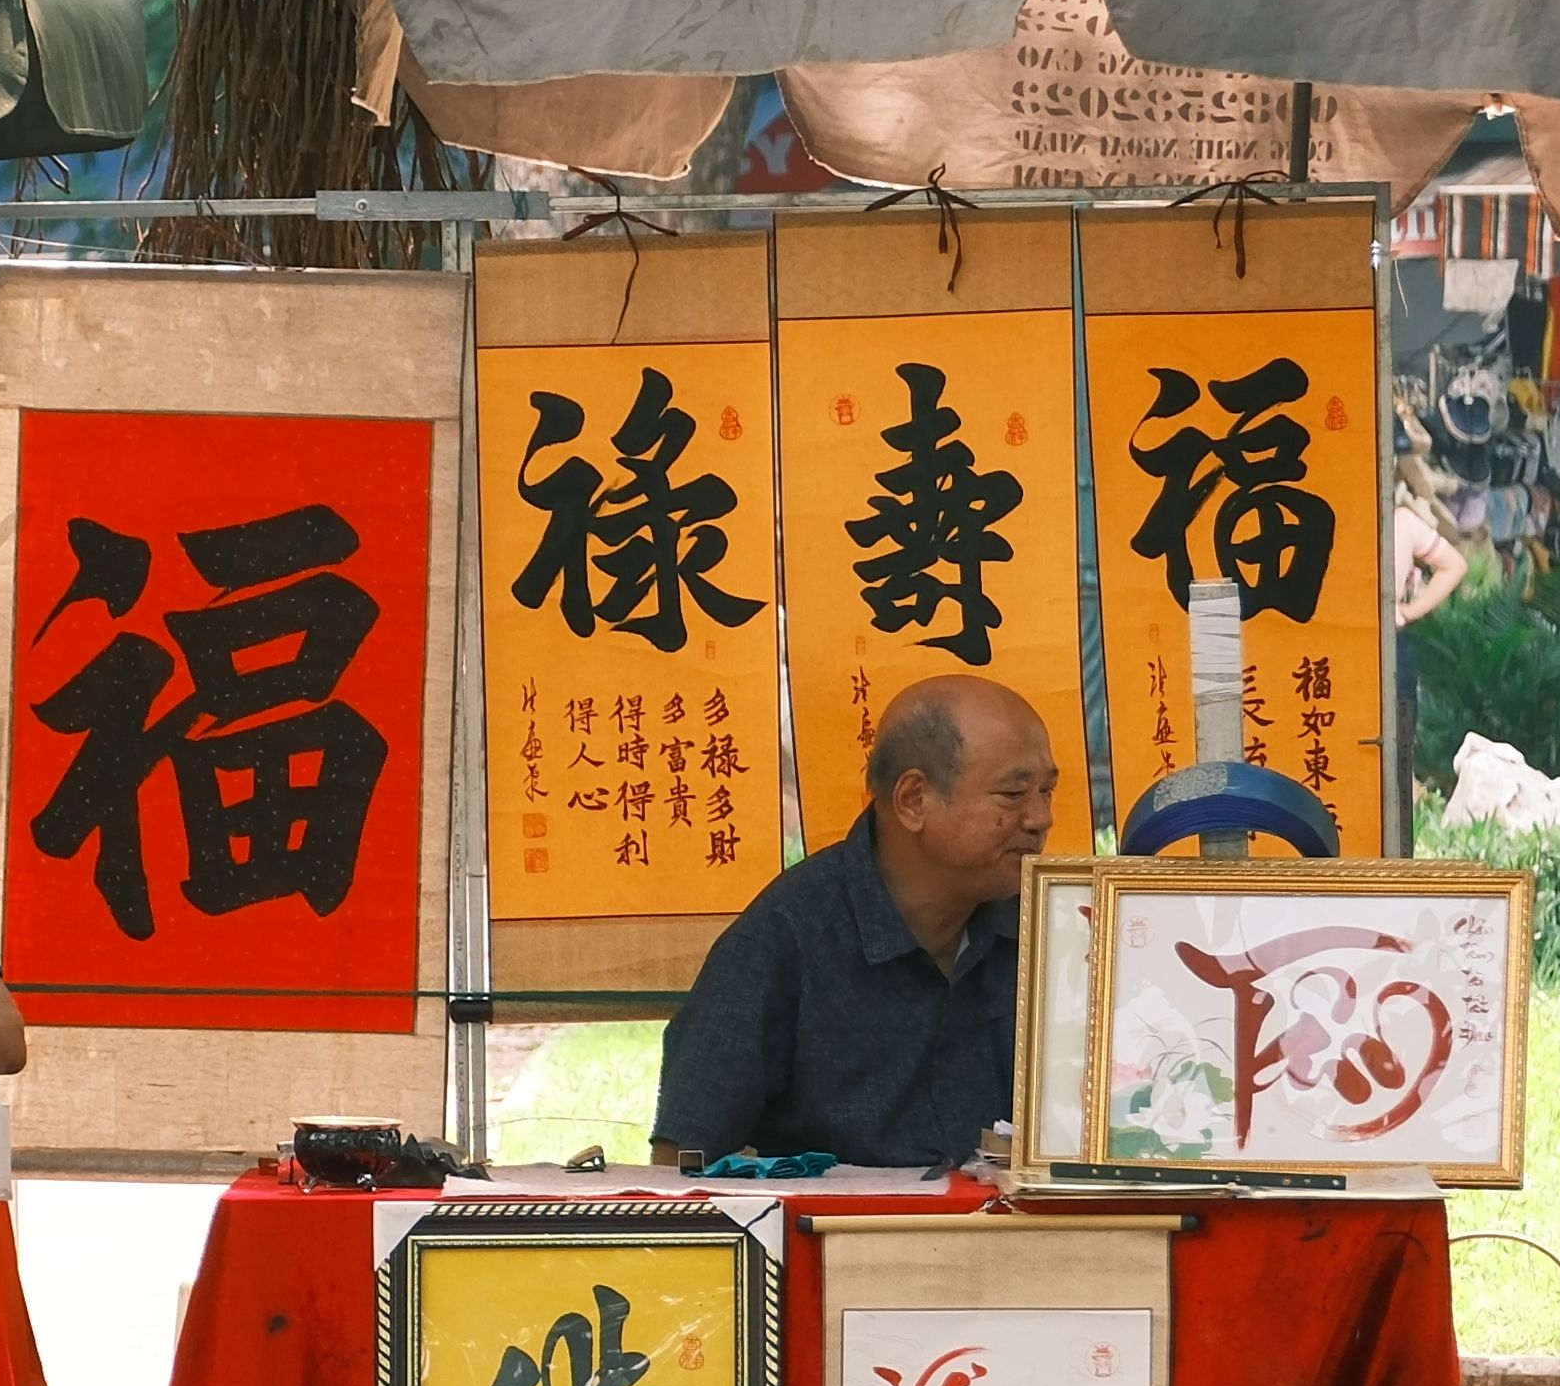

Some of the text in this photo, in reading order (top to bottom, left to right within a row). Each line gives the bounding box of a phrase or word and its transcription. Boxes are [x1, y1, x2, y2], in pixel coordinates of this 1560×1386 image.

[1129, 358, 1336, 624] 福
[30, 504, 389, 941] 福
[564, 697, 610, 811] 得人心
[609, 695, 655, 866] 得時得利
[659, 692, 696, 828] 多富貴
